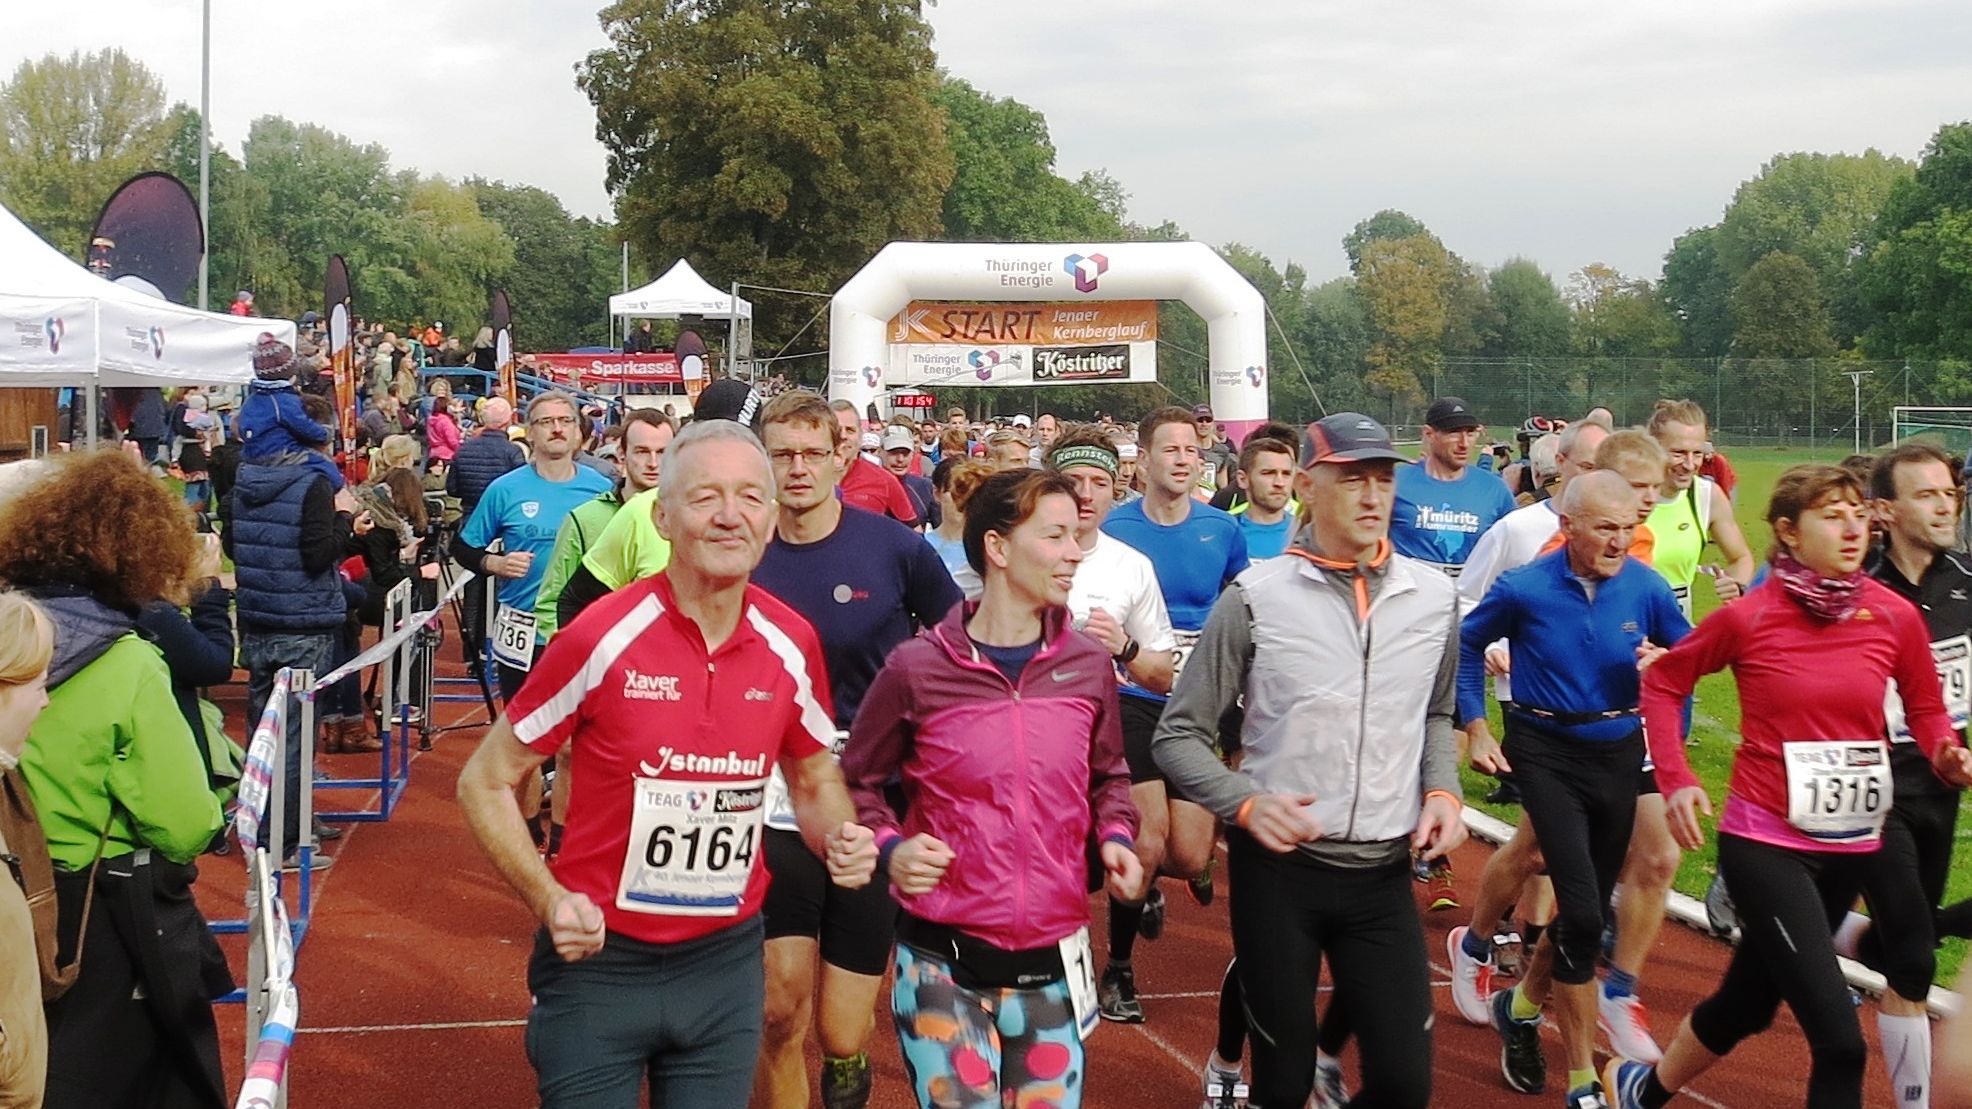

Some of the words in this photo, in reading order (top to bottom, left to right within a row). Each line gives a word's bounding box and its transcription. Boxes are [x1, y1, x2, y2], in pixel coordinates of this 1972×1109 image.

[985, 259, 1053, 275] Thüringer
[1001, 274, 1053, 288] Energie
[1053, 310, 1100, 323] Jenaer
[941, 309, 1041, 341] START
[1053, 321, 1148, 340] Kernberglauf
[591, 359, 675, 376] Sparkasse
[913, 354, 961, 365] Thüringer
[1036, 350, 1126, 378] Köstritzer
[923, 364, 962, 376] Energie
[1430, 510, 1480, 526] müritz
[624, 669, 680, 691] Xaver
[624, 688, 664, 701] trainiert
[648, 792, 682, 808] TEAG
[1804, 776, 1880, 814] 1316
[645, 825, 755, 871] 6164
